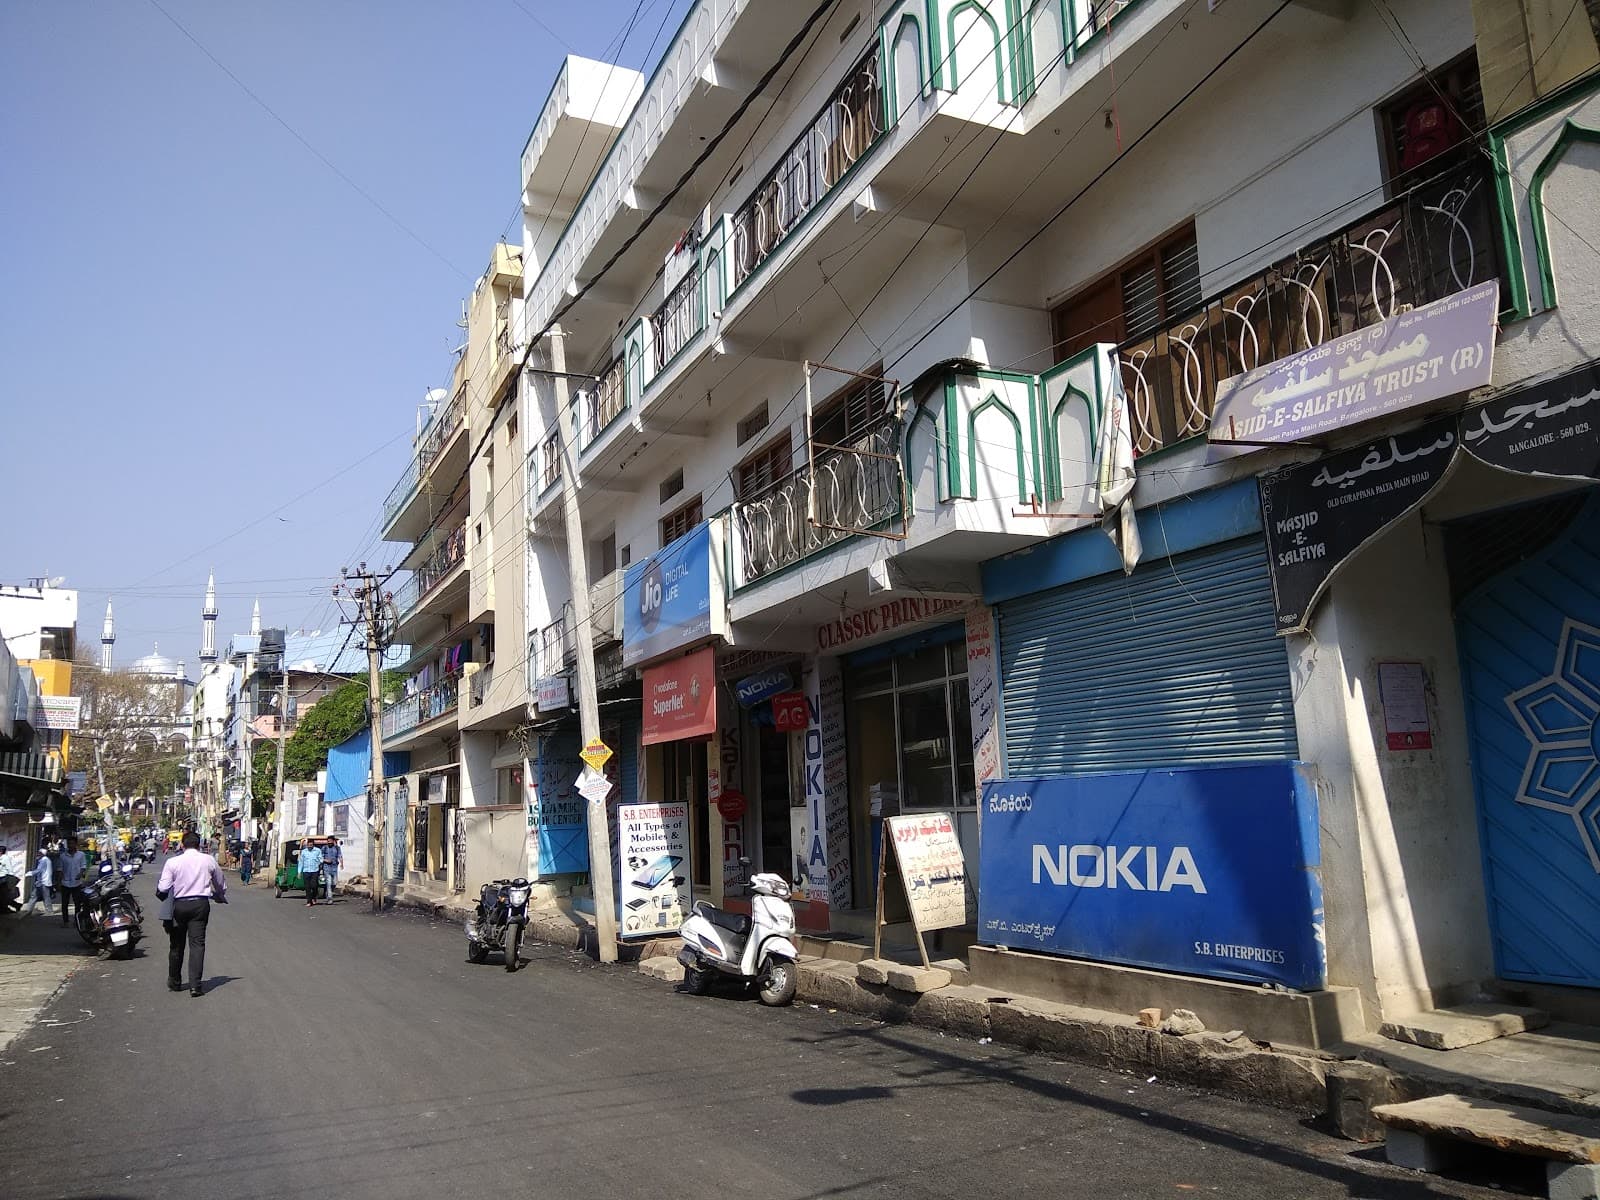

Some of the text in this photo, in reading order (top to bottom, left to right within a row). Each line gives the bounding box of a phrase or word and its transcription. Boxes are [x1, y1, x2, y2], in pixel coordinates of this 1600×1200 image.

[1373, 356, 1444, 397] TRUST
[1450, 341, 1484, 376] (R)
[1301, 423, 1318, 433] Main
[1508, 432, 1556, 455] BANGALORE
[1560, 426, 1574, 440] 560
[1326, 497, 1340, 510] OLD
[1375, 482, 1394, 497] PALYA
[1393, 477, 1411, 491] MAIN
[1411, 471, 1430, 485] ROAD
[1276, 511, 1320, 535] MASJID
[1291, 531, 1308, 546] -E-
[1278, 542, 1327, 567] SALFIYA
[665, 561, 689, 586] DIGITAL
[641, 577, 662, 614] Jio
[665, 584, 679, 603] LIFE
[818, 608, 880, 649] CLASSIC
[657, 679, 678, 694] vodafone
[737, 672, 788, 699] NOKIA
[653, 692, 684, 718] SuperNet
[777, 706, 804, 726] 4G
[805, 694, 827, 867] NOKIA
[721, 727, 742, 862] Karnn
[528, 802, 577, 815] ISLAMIC
[623, 806, 684, 821] S.B. ENTERPRISES
[627, 820, 682, 833] All Types of
[630, 831, 680, 843] Mobiles &
[627, 842, 684, 854] Accessories
[828, 858, 849, 881] DTP
[1031, 844, 1208, 894] NOKIA
[830, 874, 850, 895] WORKS
[1194, 941, 1286, 965] S.B. ENTERPRISES
